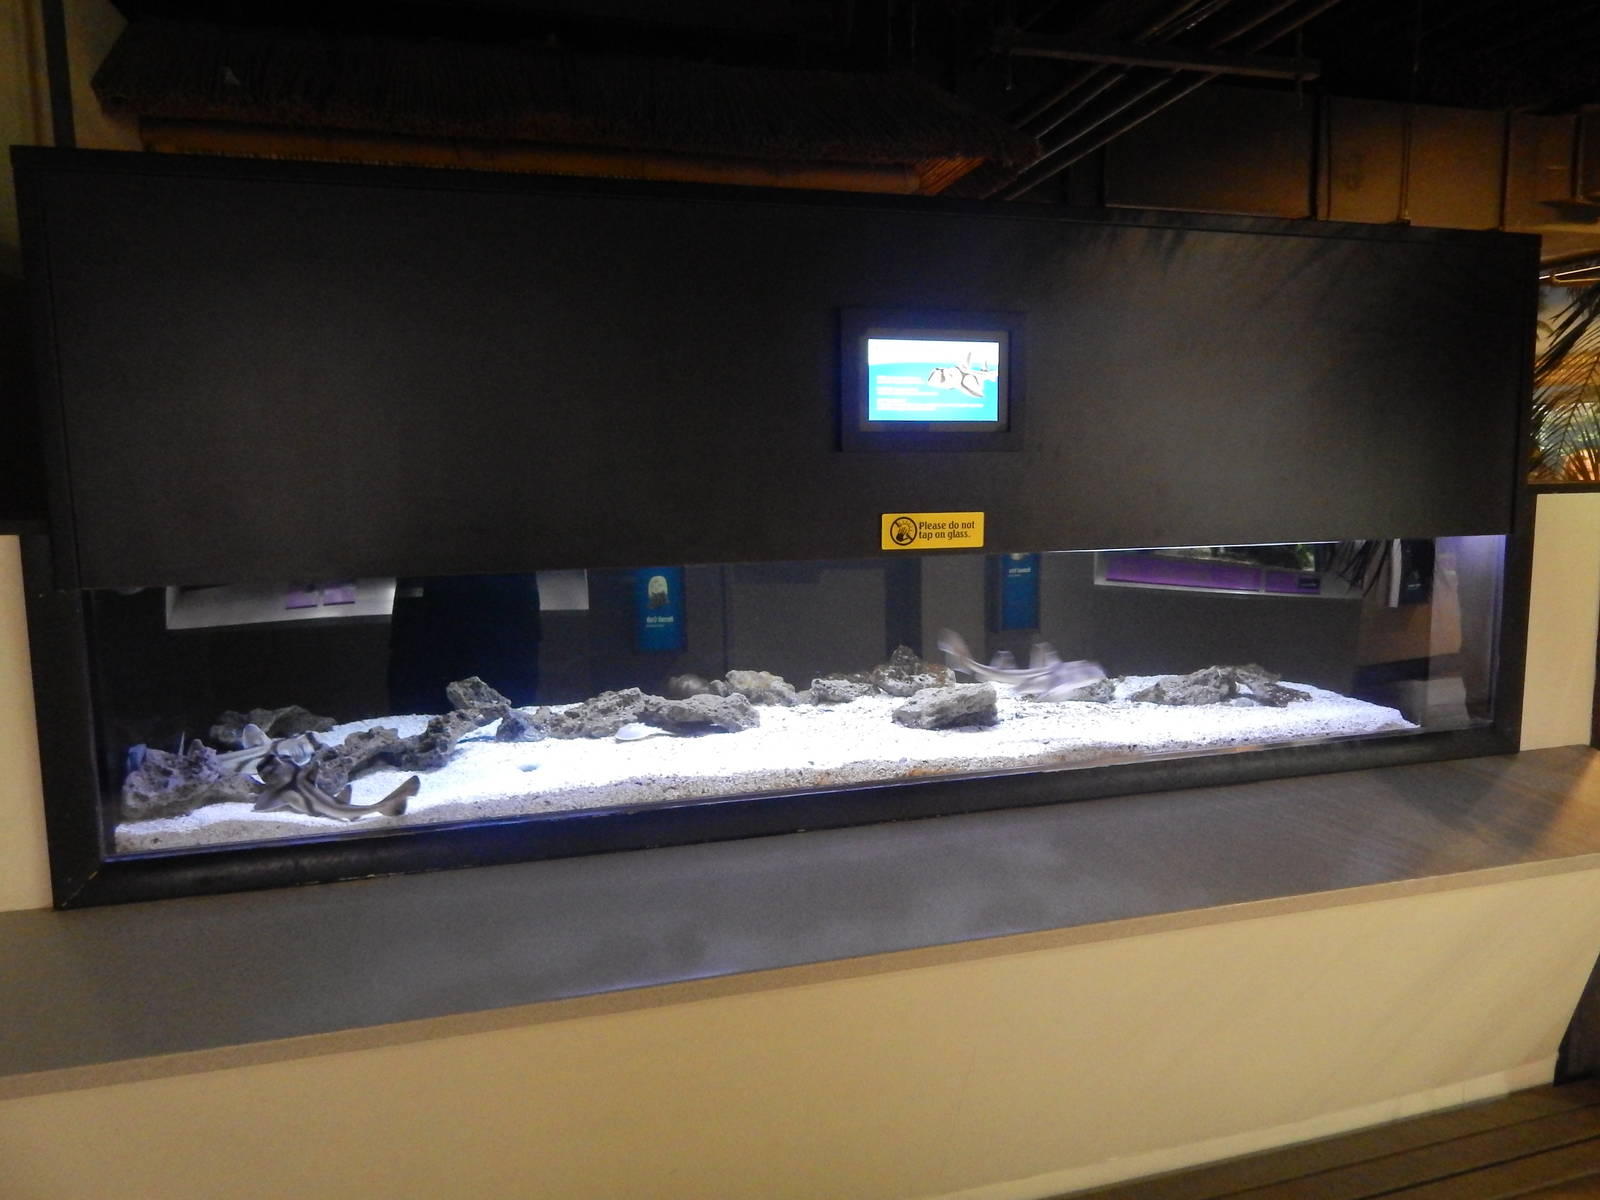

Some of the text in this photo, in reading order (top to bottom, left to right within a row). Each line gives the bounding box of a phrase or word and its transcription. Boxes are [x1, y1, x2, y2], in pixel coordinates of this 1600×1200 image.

[919, 520, 975, 530] Please do not
[919, 529, 971, 541] tap on glass.
